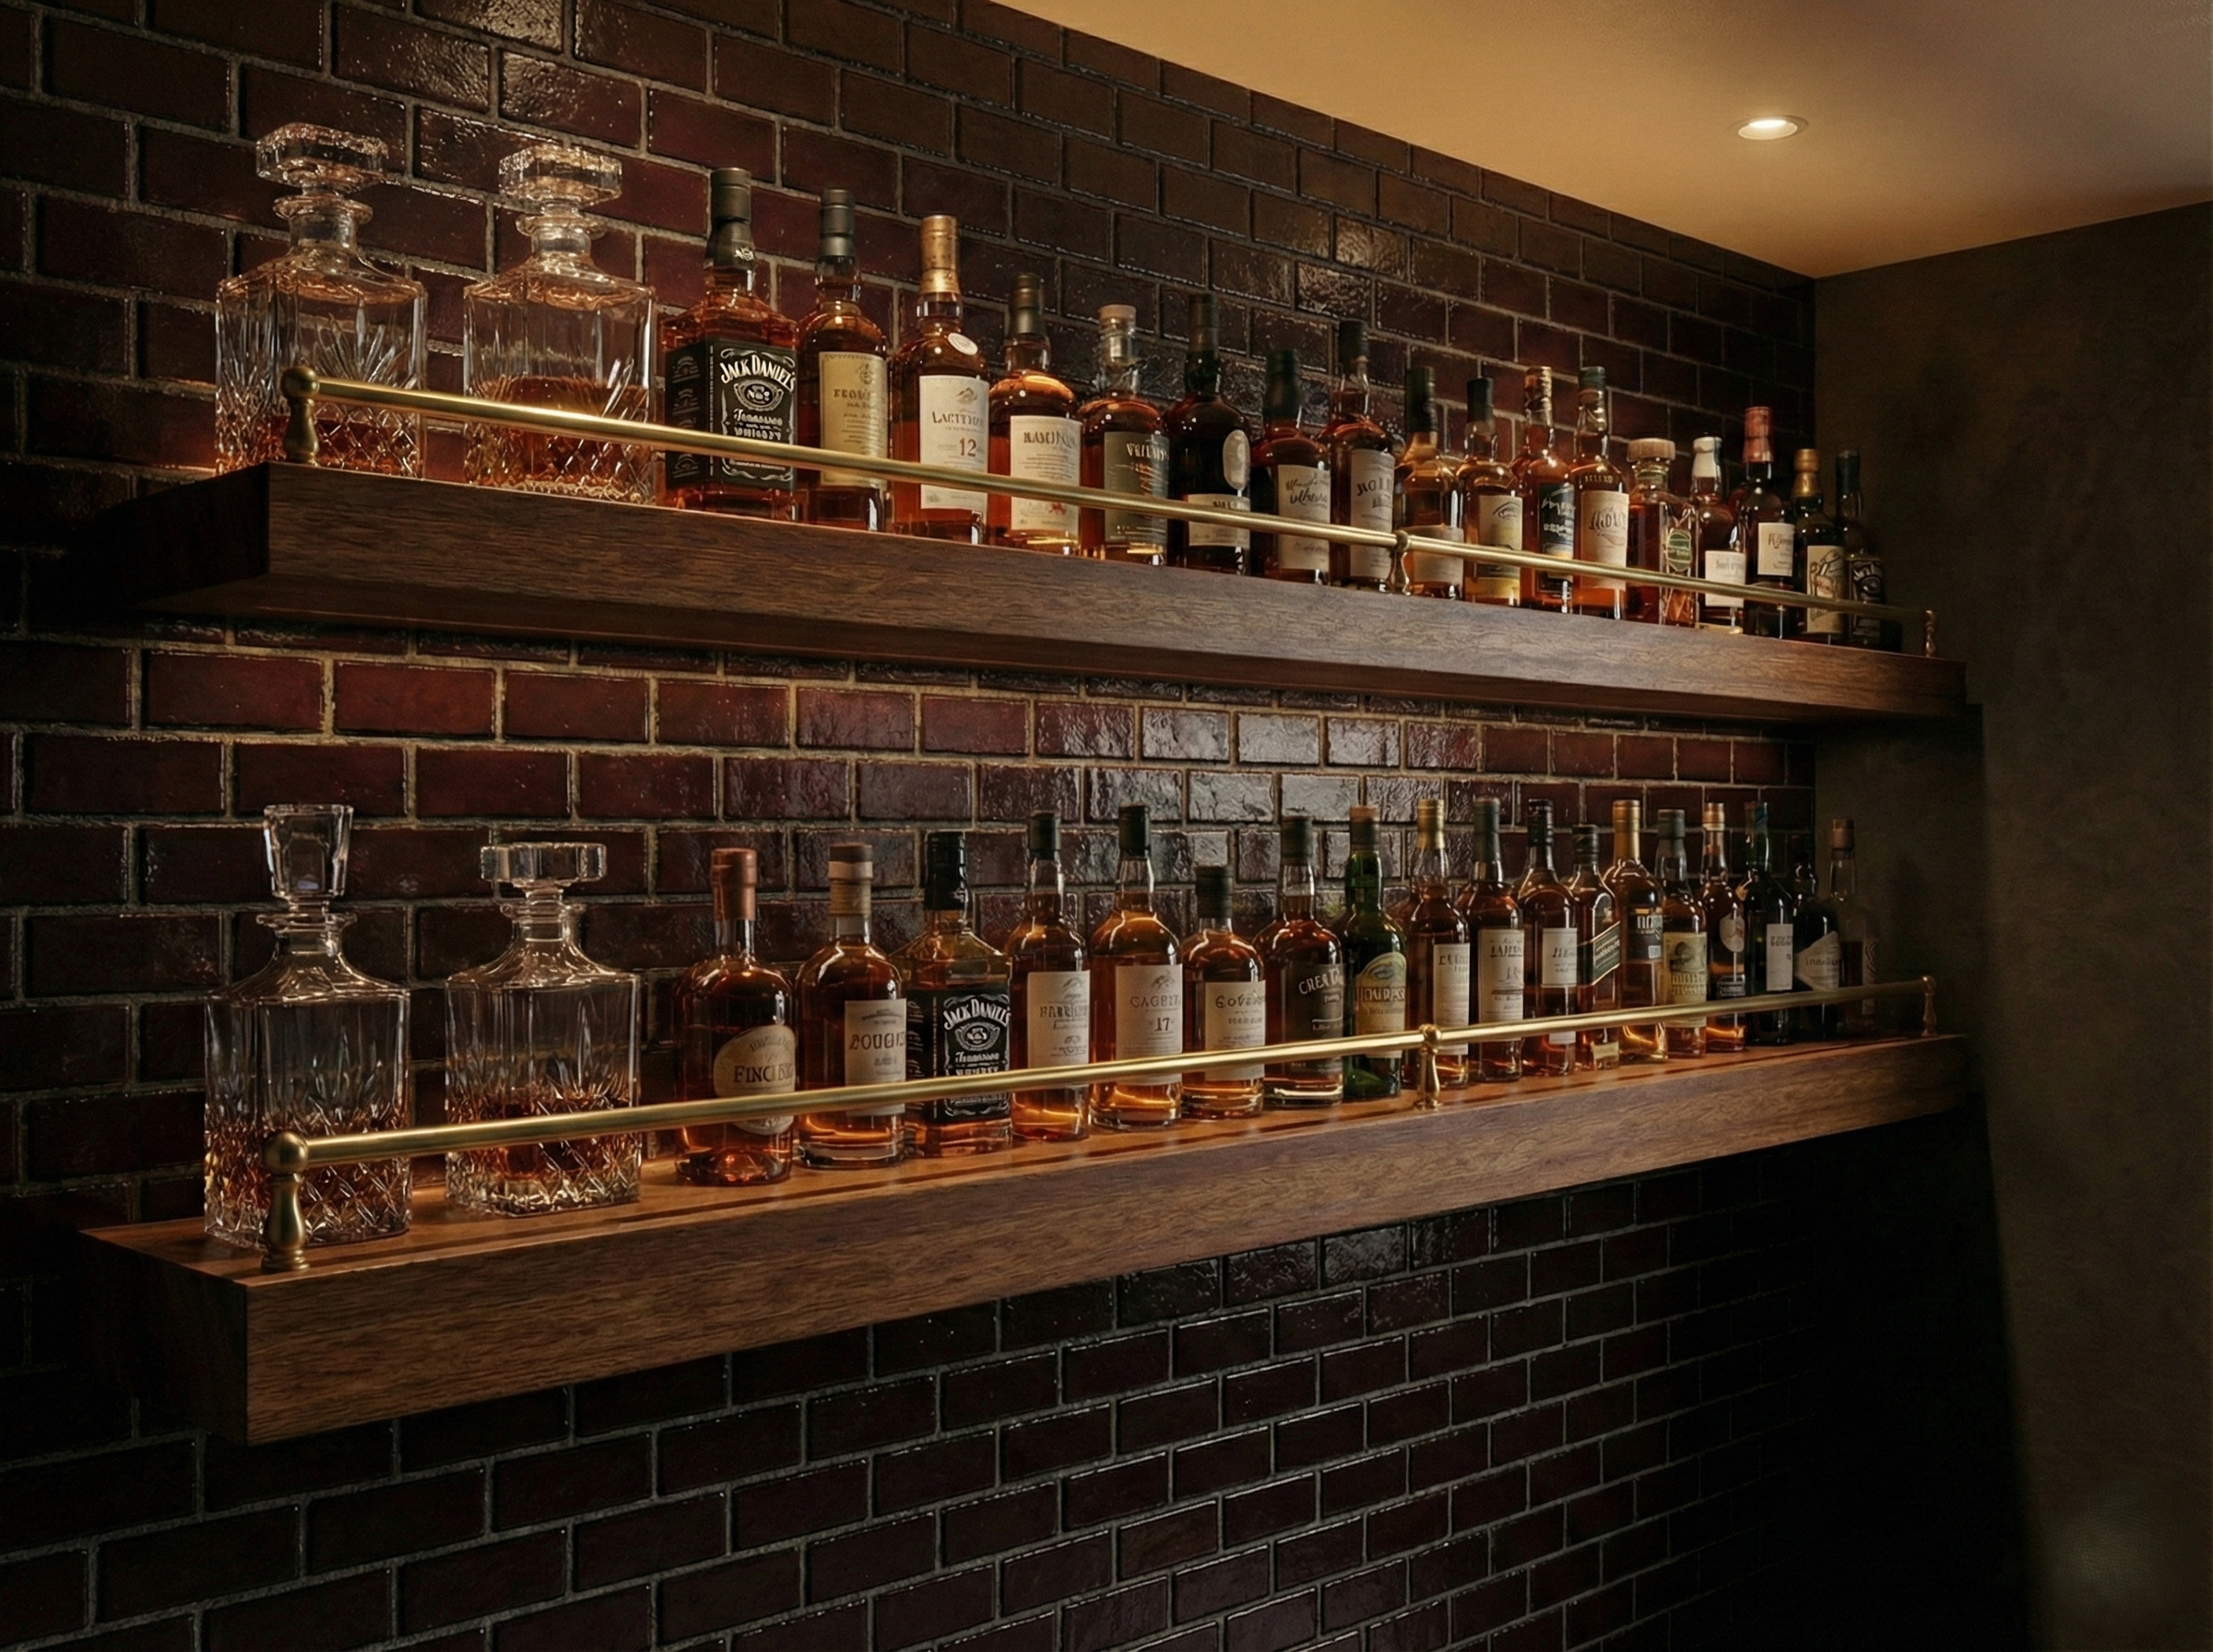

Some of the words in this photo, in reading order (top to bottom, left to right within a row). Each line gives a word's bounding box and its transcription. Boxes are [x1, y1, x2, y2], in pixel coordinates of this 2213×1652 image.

[720, 359, 751, 384] JACK
[959, 437, 977, 457] 12
[943, 1002, 972, 1031] JACK
[1154, 1017, 1171, 1032] 17
